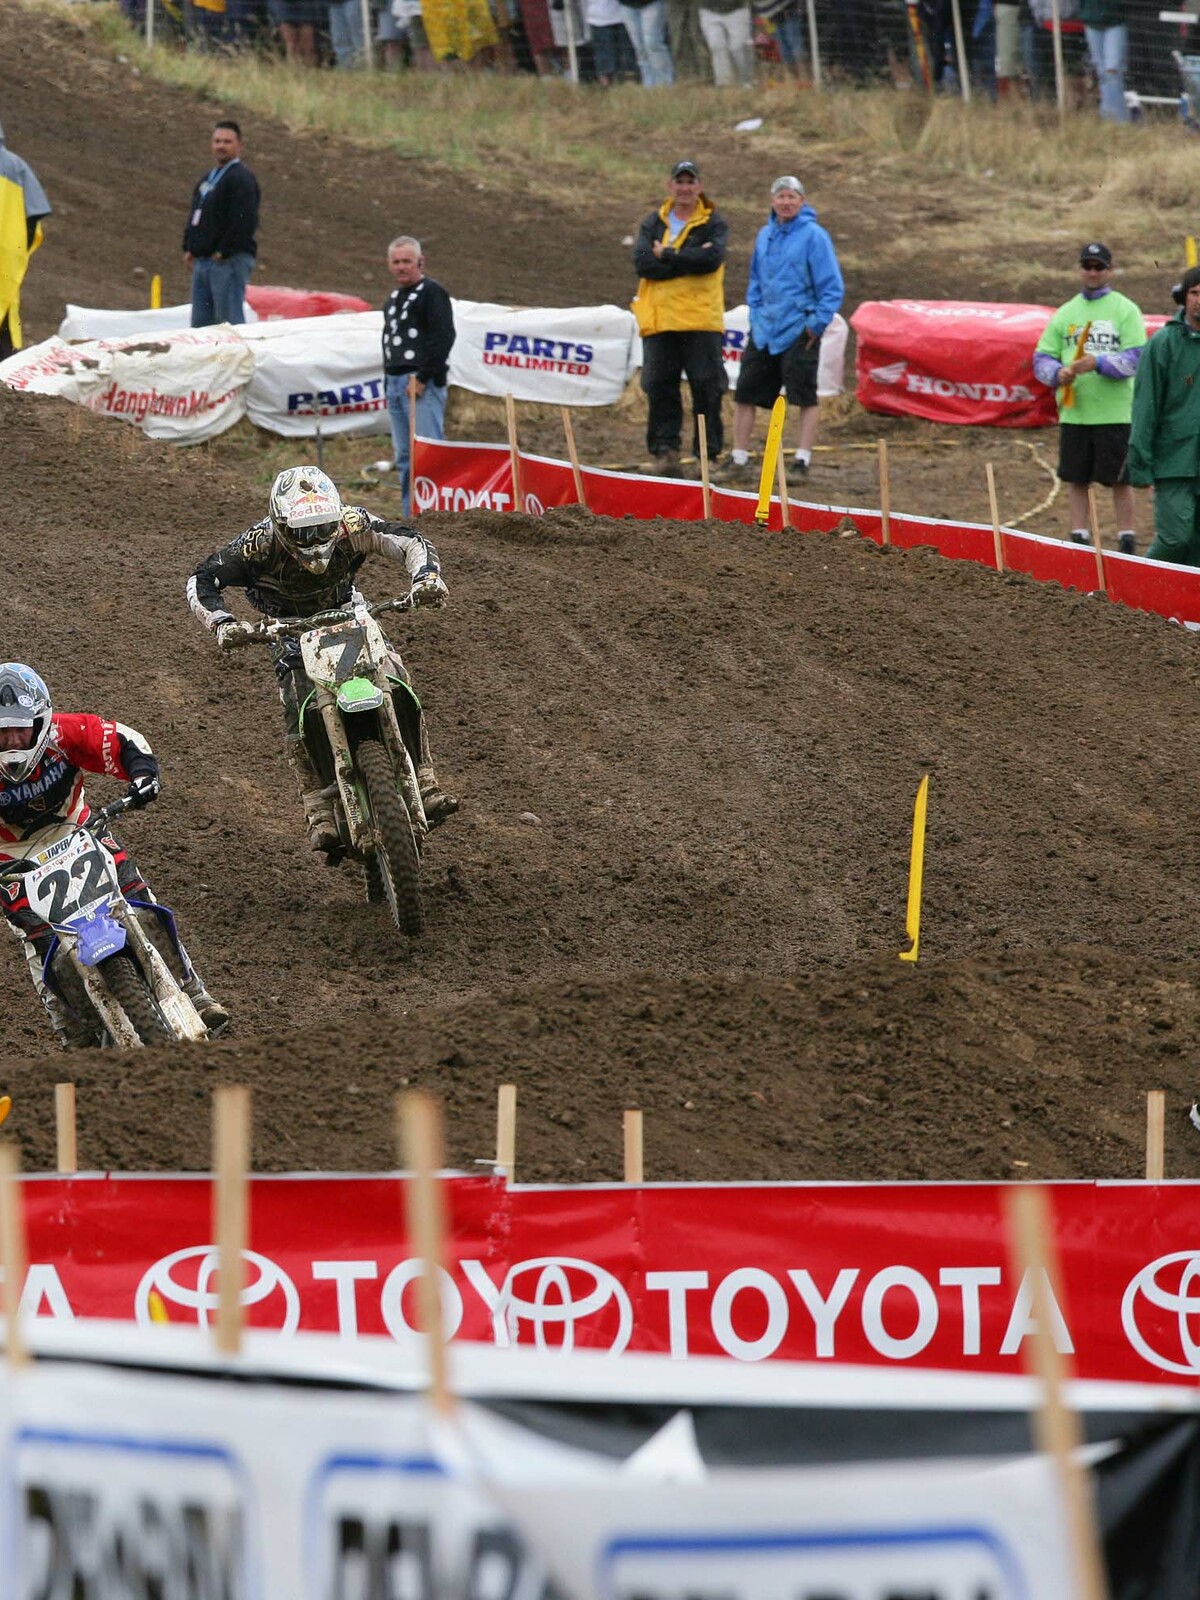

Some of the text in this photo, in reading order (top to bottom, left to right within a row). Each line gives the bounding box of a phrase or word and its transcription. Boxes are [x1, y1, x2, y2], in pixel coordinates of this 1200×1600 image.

[484, 332, 594, 363] PARTS
[483, 352, 590, 377] UNLIMITED
[288, 379, 382, 411] PART
[906, 373, 1036, 402] HONDA
[289, 503, 338, 519] Red Bull
[441, 486, 511, 513] TOYOT
[319, 625, 368, 682] 7
[11, 761, 68, 801] YAMAHA
[46, 838, 72, 859] TAPER
[37, 850, 115, 924] 22
[312, 1256, 511, 1348] TOY
[646, 1265, 1075, 1362] TOYOTA
